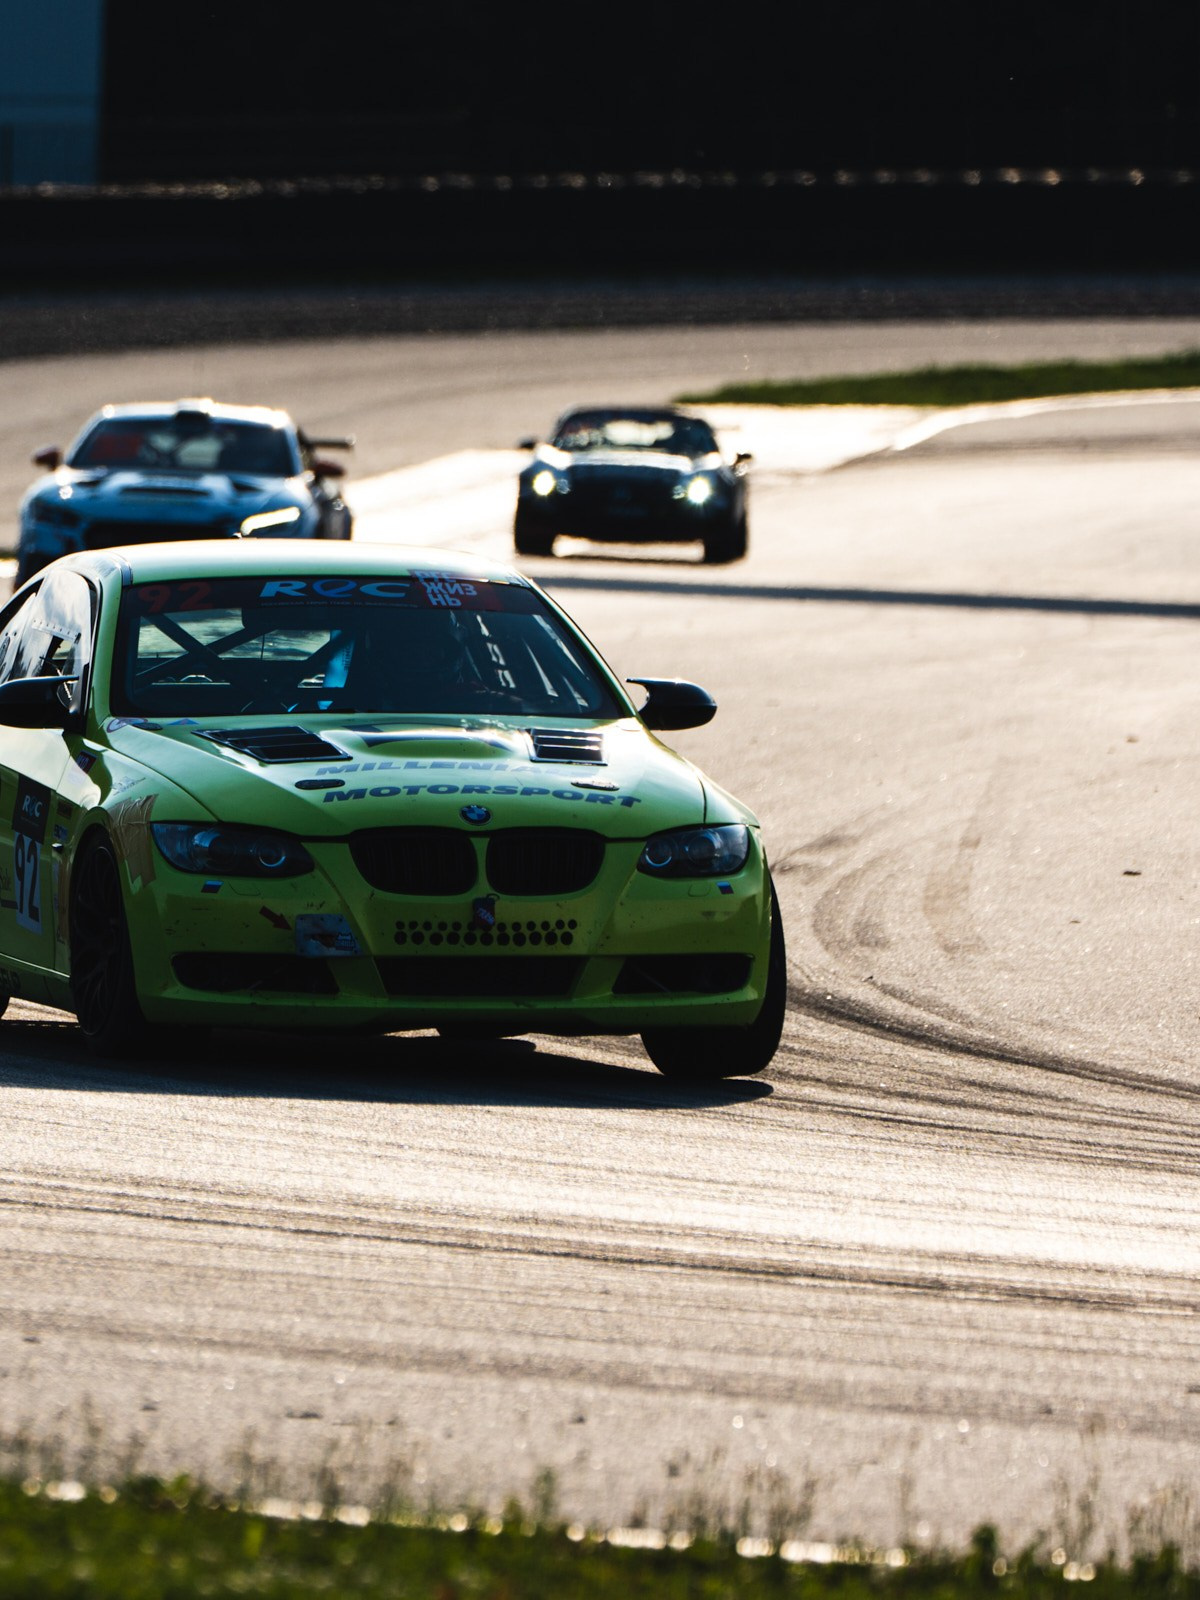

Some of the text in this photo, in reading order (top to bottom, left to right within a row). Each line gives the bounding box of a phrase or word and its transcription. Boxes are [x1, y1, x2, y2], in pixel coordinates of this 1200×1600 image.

[138, 581, 214, 613] 92
[421, 582, 478, 596] ЖИЗ
[427, 593, 462, 606] НЬ
[322, 784, 642, 808] MOTORSPORT
[15, 833, 40, 923] 92
